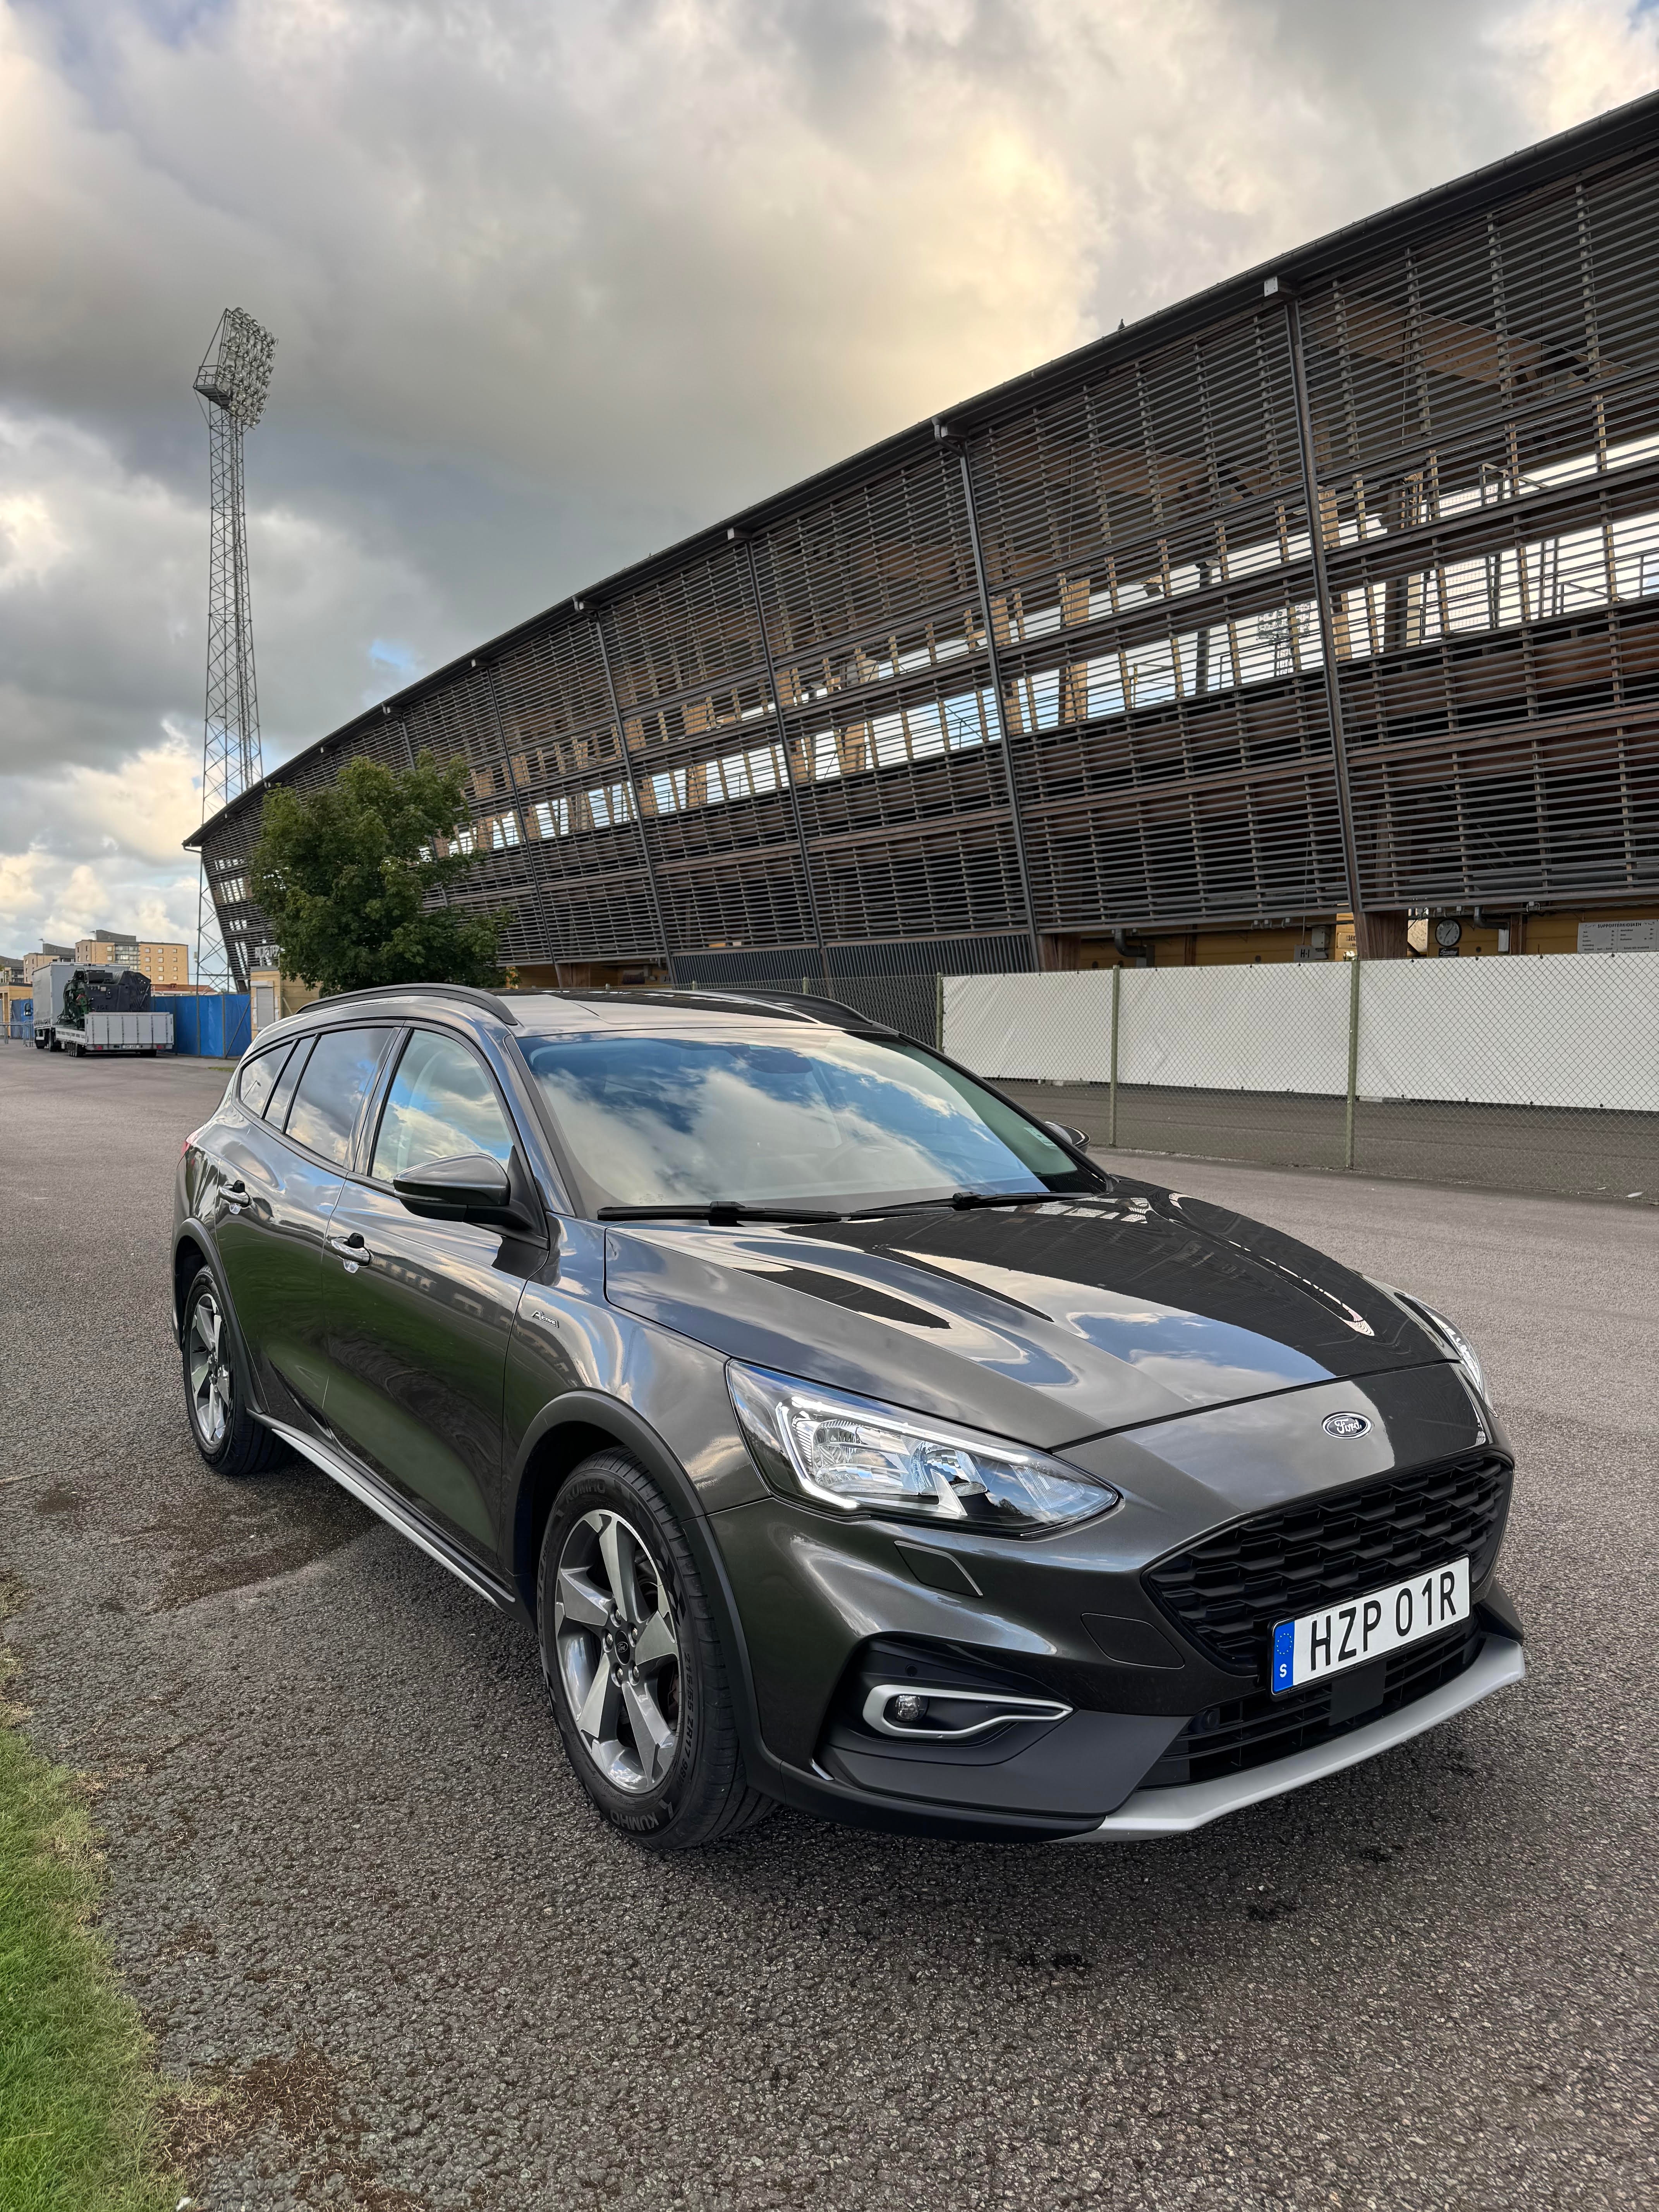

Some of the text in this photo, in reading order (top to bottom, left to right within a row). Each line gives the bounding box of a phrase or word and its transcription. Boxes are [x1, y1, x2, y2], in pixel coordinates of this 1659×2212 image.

[1334, 1418, 1362, 1434] Ford
[564, 1479, 606, 1504] KUMHO
[1310, 1571, 1456, 1671] HZP 01R
[684, 1652, 694, 1712] 215/55
[1279, 1664, 1287, 1678] S
[685, 1715, 694, 1759] ZR17
[610, 1809, 659, 1831] KUMHO
